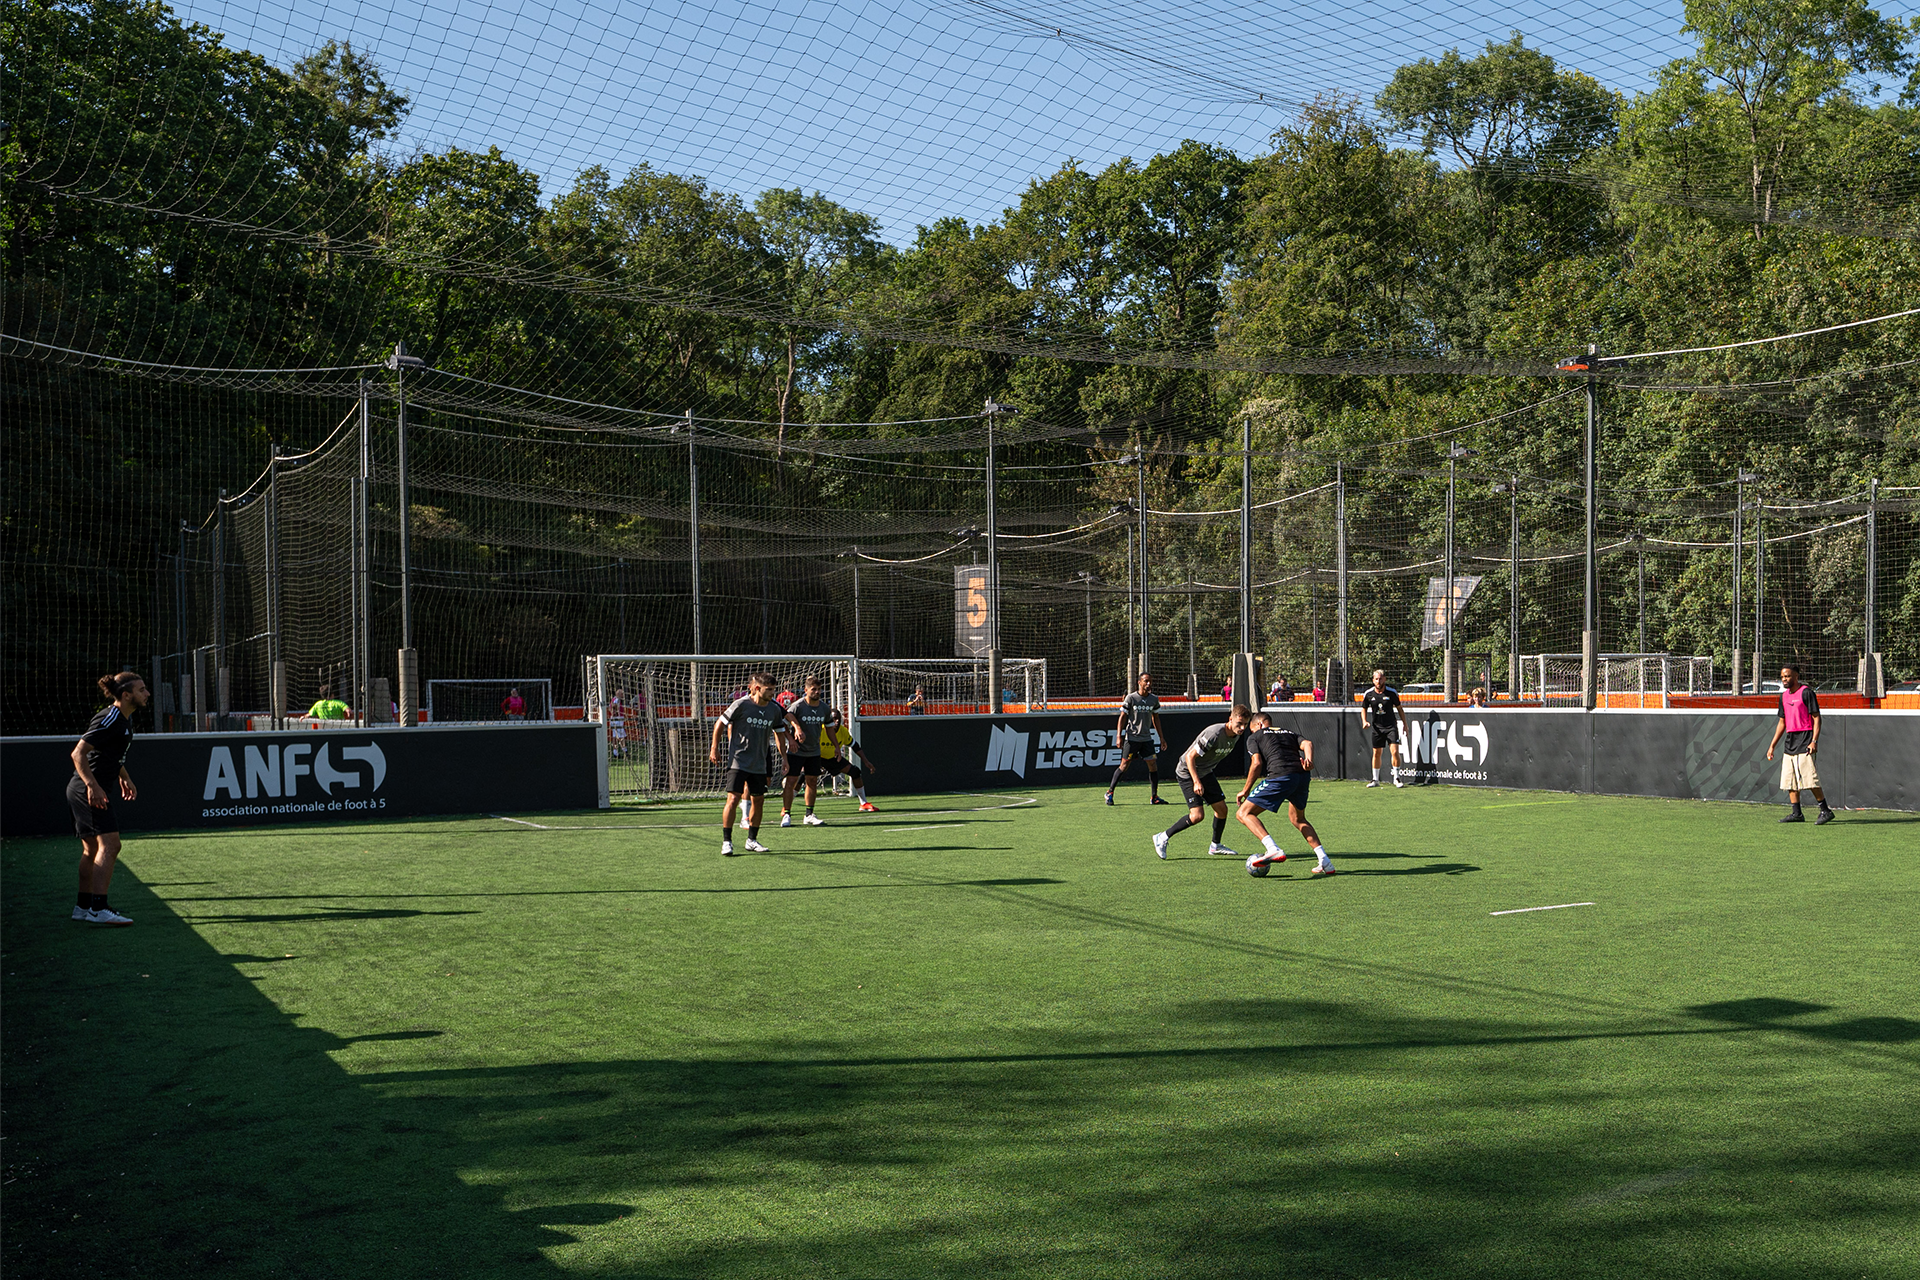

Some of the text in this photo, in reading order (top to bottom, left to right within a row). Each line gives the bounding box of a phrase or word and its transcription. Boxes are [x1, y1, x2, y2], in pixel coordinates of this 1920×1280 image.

[966, 577, 987, 628] 5
[1037, 728, 1161, 749] MASTR
[1035, 748, 1122, 769] LIGUE
[1390, 768, 1488, 781] aociation nationale de foot à 5
[202, 798, 387, 818] association nationale de foot à 5
